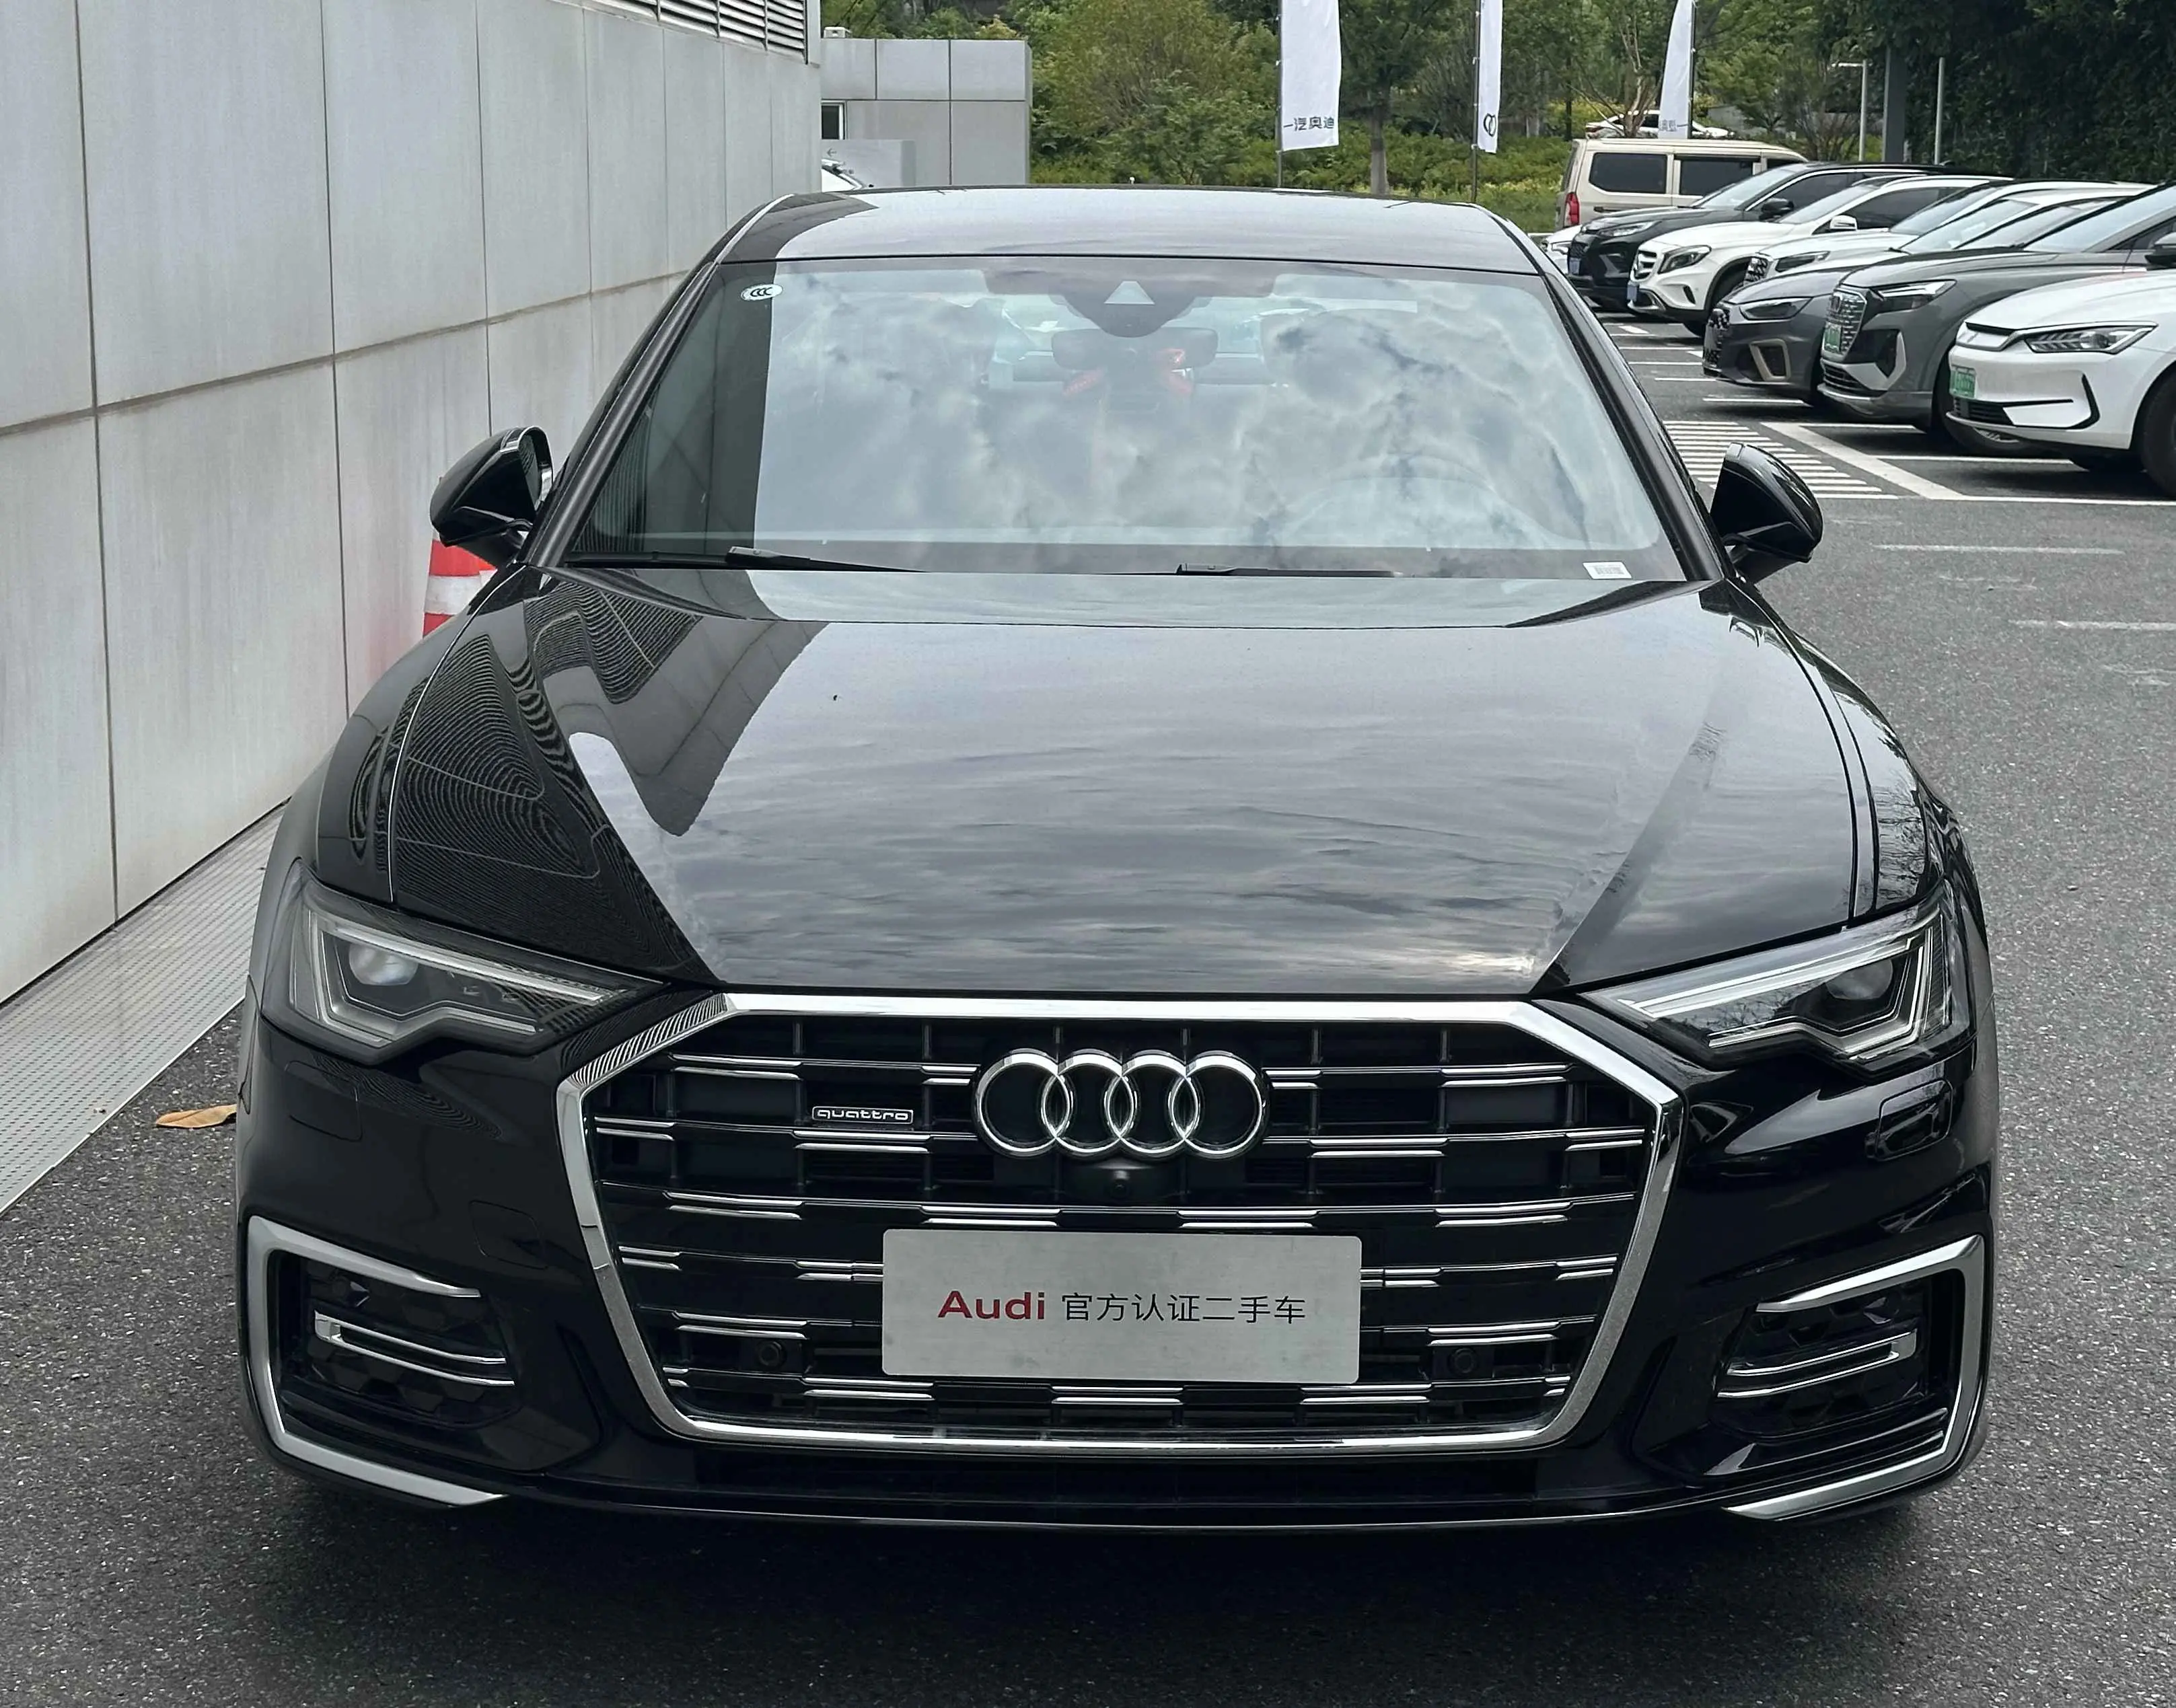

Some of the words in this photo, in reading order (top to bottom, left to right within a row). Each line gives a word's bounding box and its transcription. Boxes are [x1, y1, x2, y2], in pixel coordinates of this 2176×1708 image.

[817, 1109, 908, 1121] quattro
[938, 1290, 1045, 1320] Audi
[1062, 1292, 1306, 1324] 官方认证二手车
